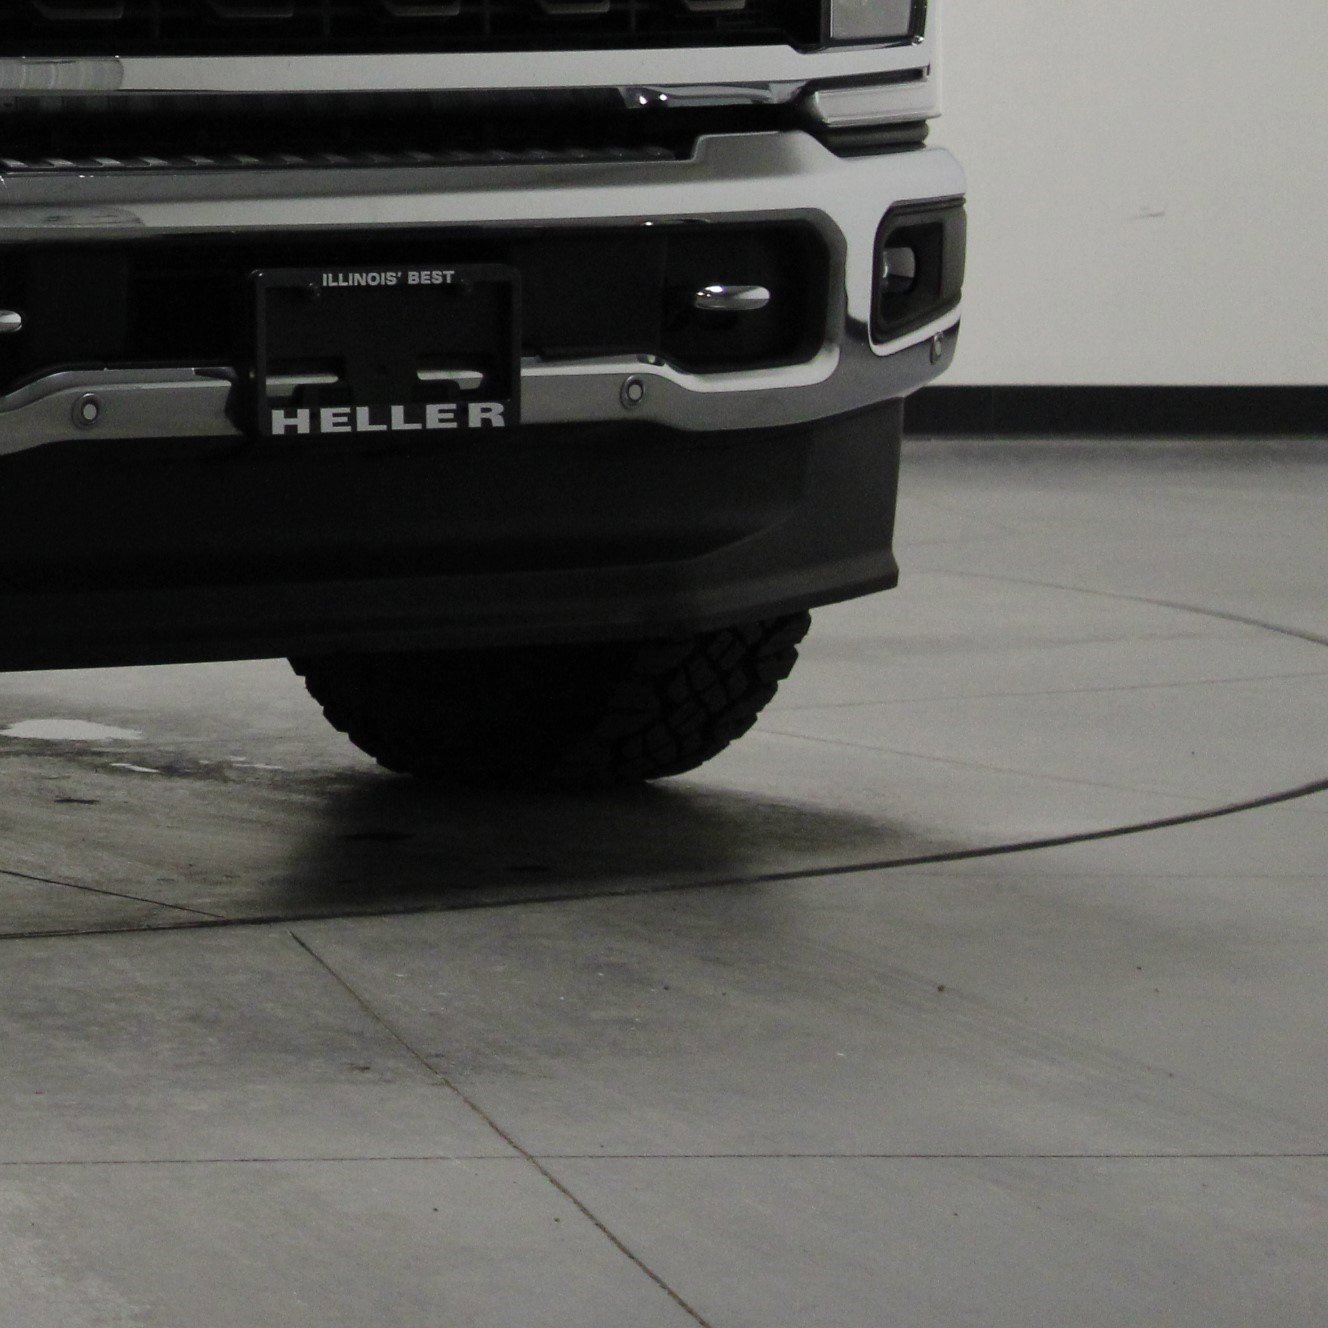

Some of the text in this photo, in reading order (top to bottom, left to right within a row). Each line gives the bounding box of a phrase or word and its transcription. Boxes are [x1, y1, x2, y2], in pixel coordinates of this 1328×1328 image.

[322, 270, 455, 287] ILLINOIS' BEST
[270, 402, 506, 435] HELLER
